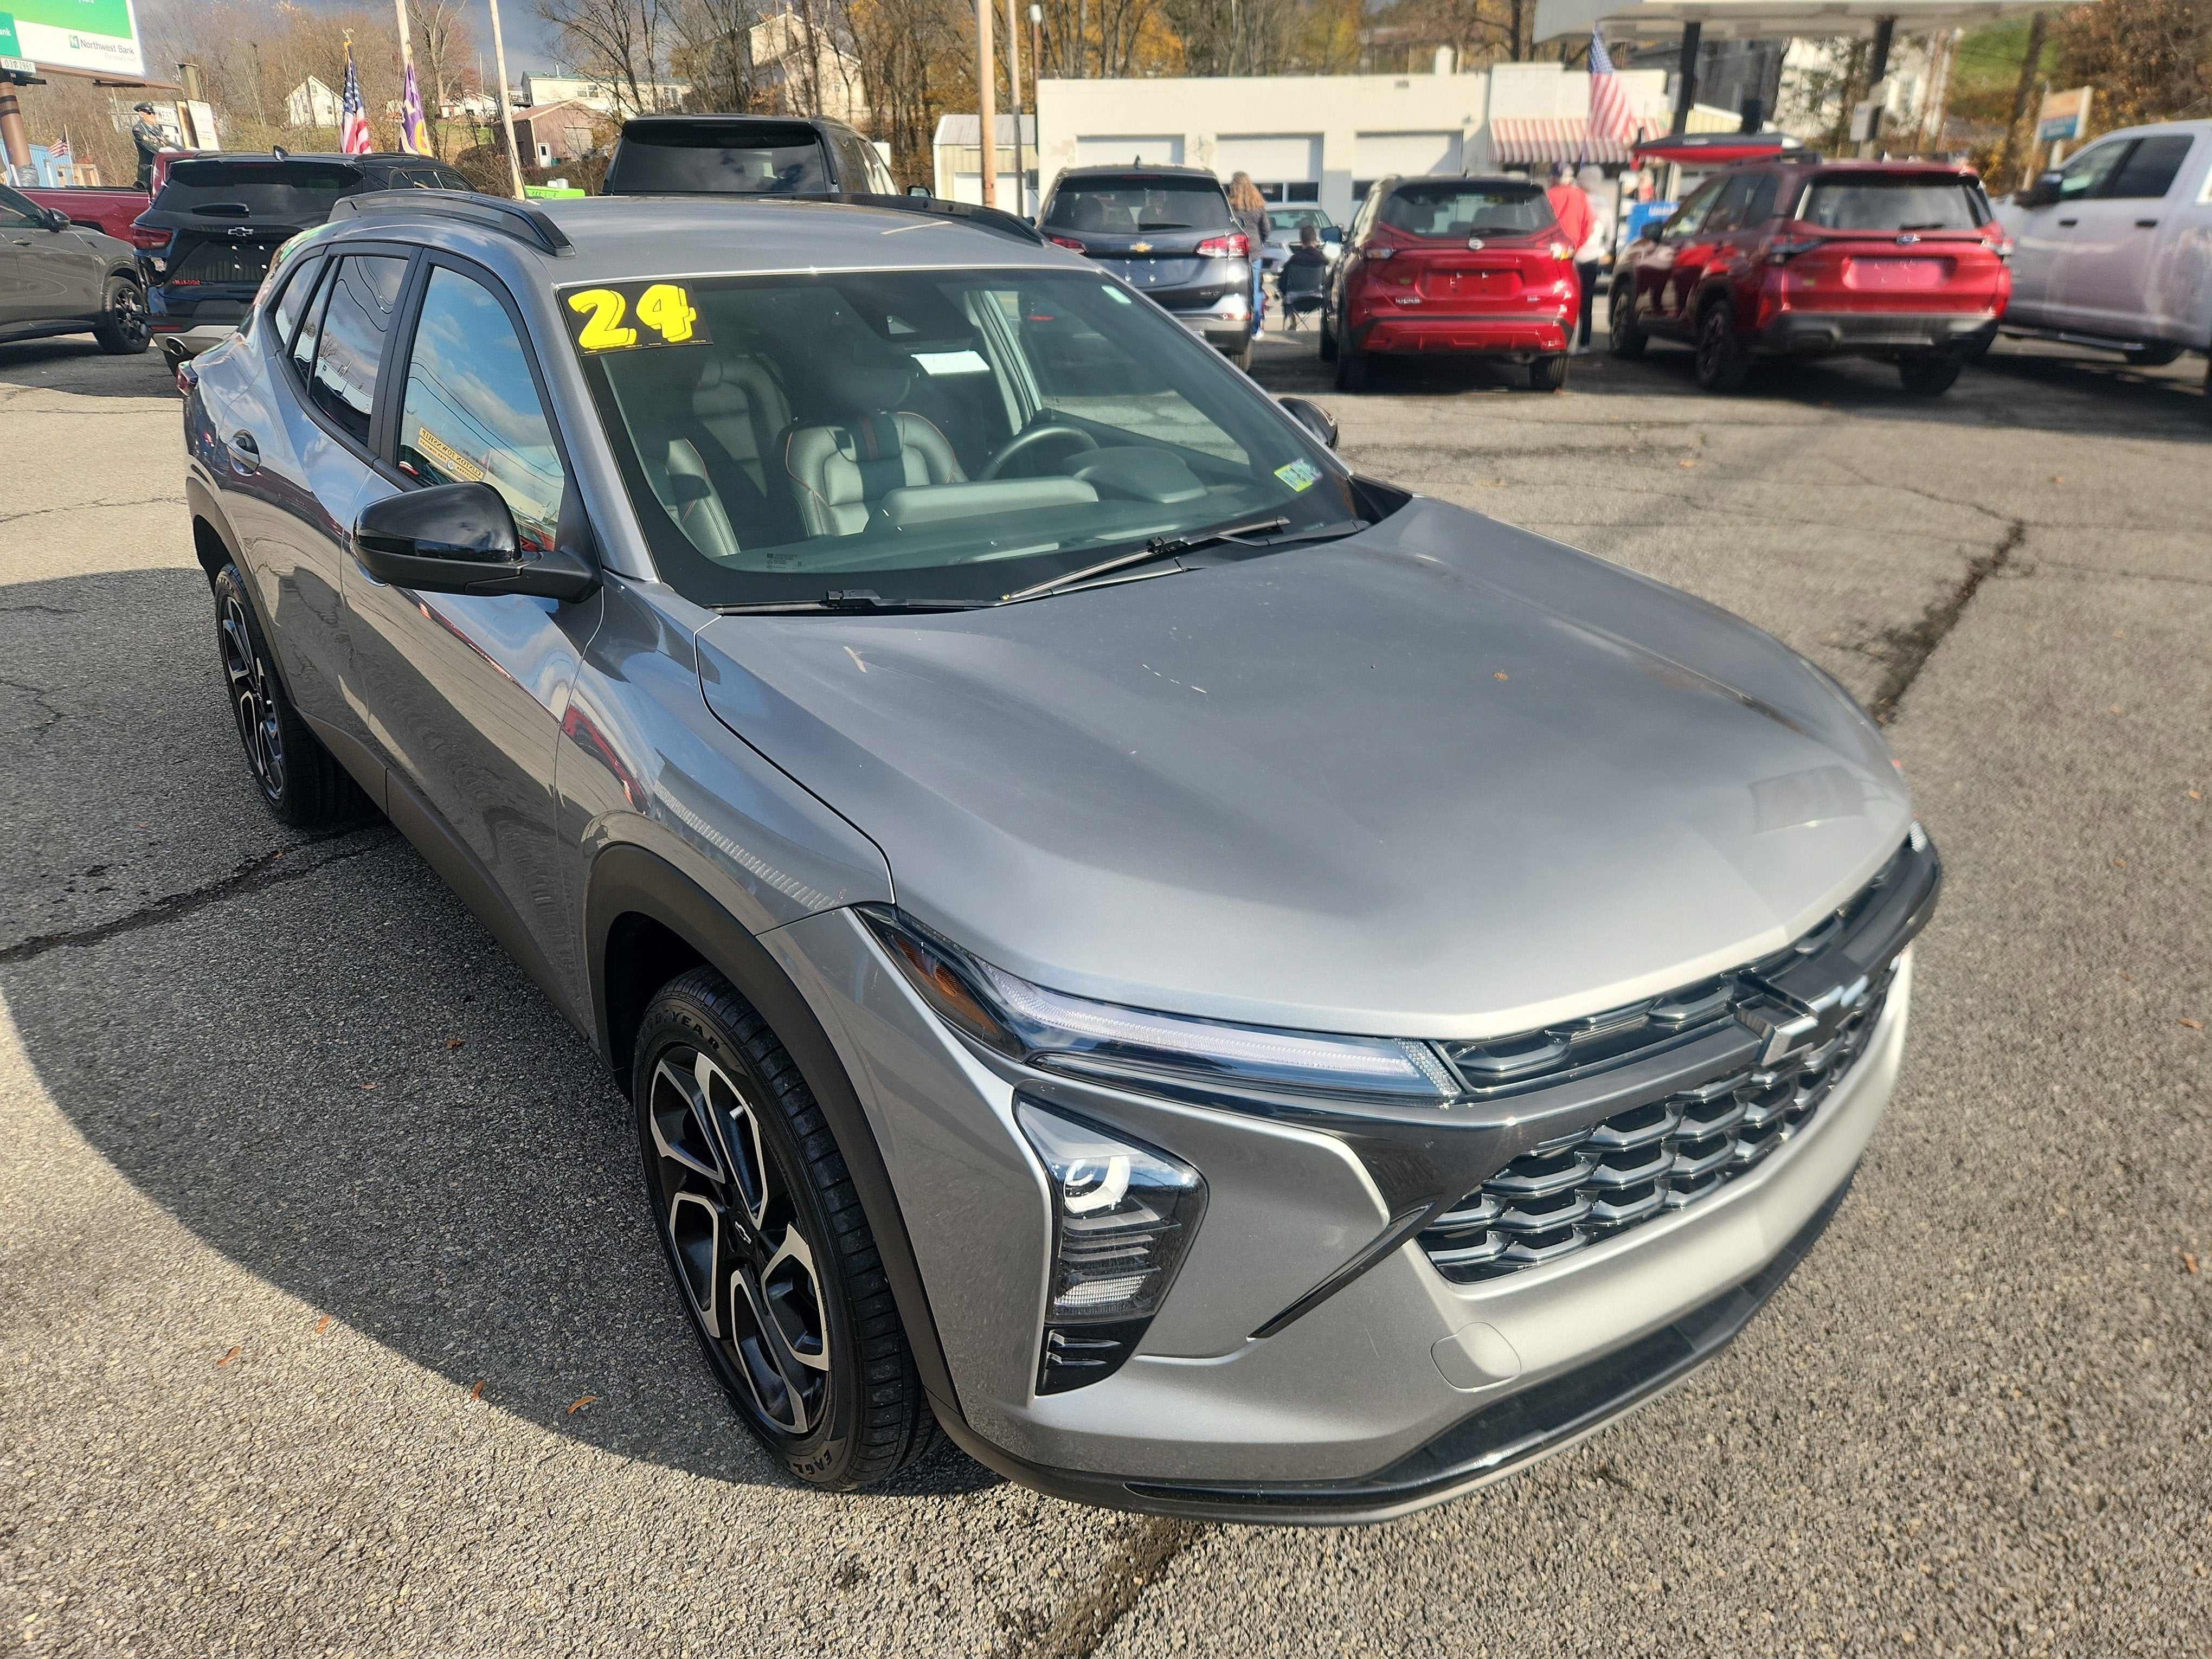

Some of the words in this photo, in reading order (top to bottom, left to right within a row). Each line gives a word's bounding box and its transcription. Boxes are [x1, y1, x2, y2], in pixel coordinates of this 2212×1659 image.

[80, 38, 116, 52] Northwest
[118, 44, 134, 54] Bank
[568, 284, 697, 350] 24
